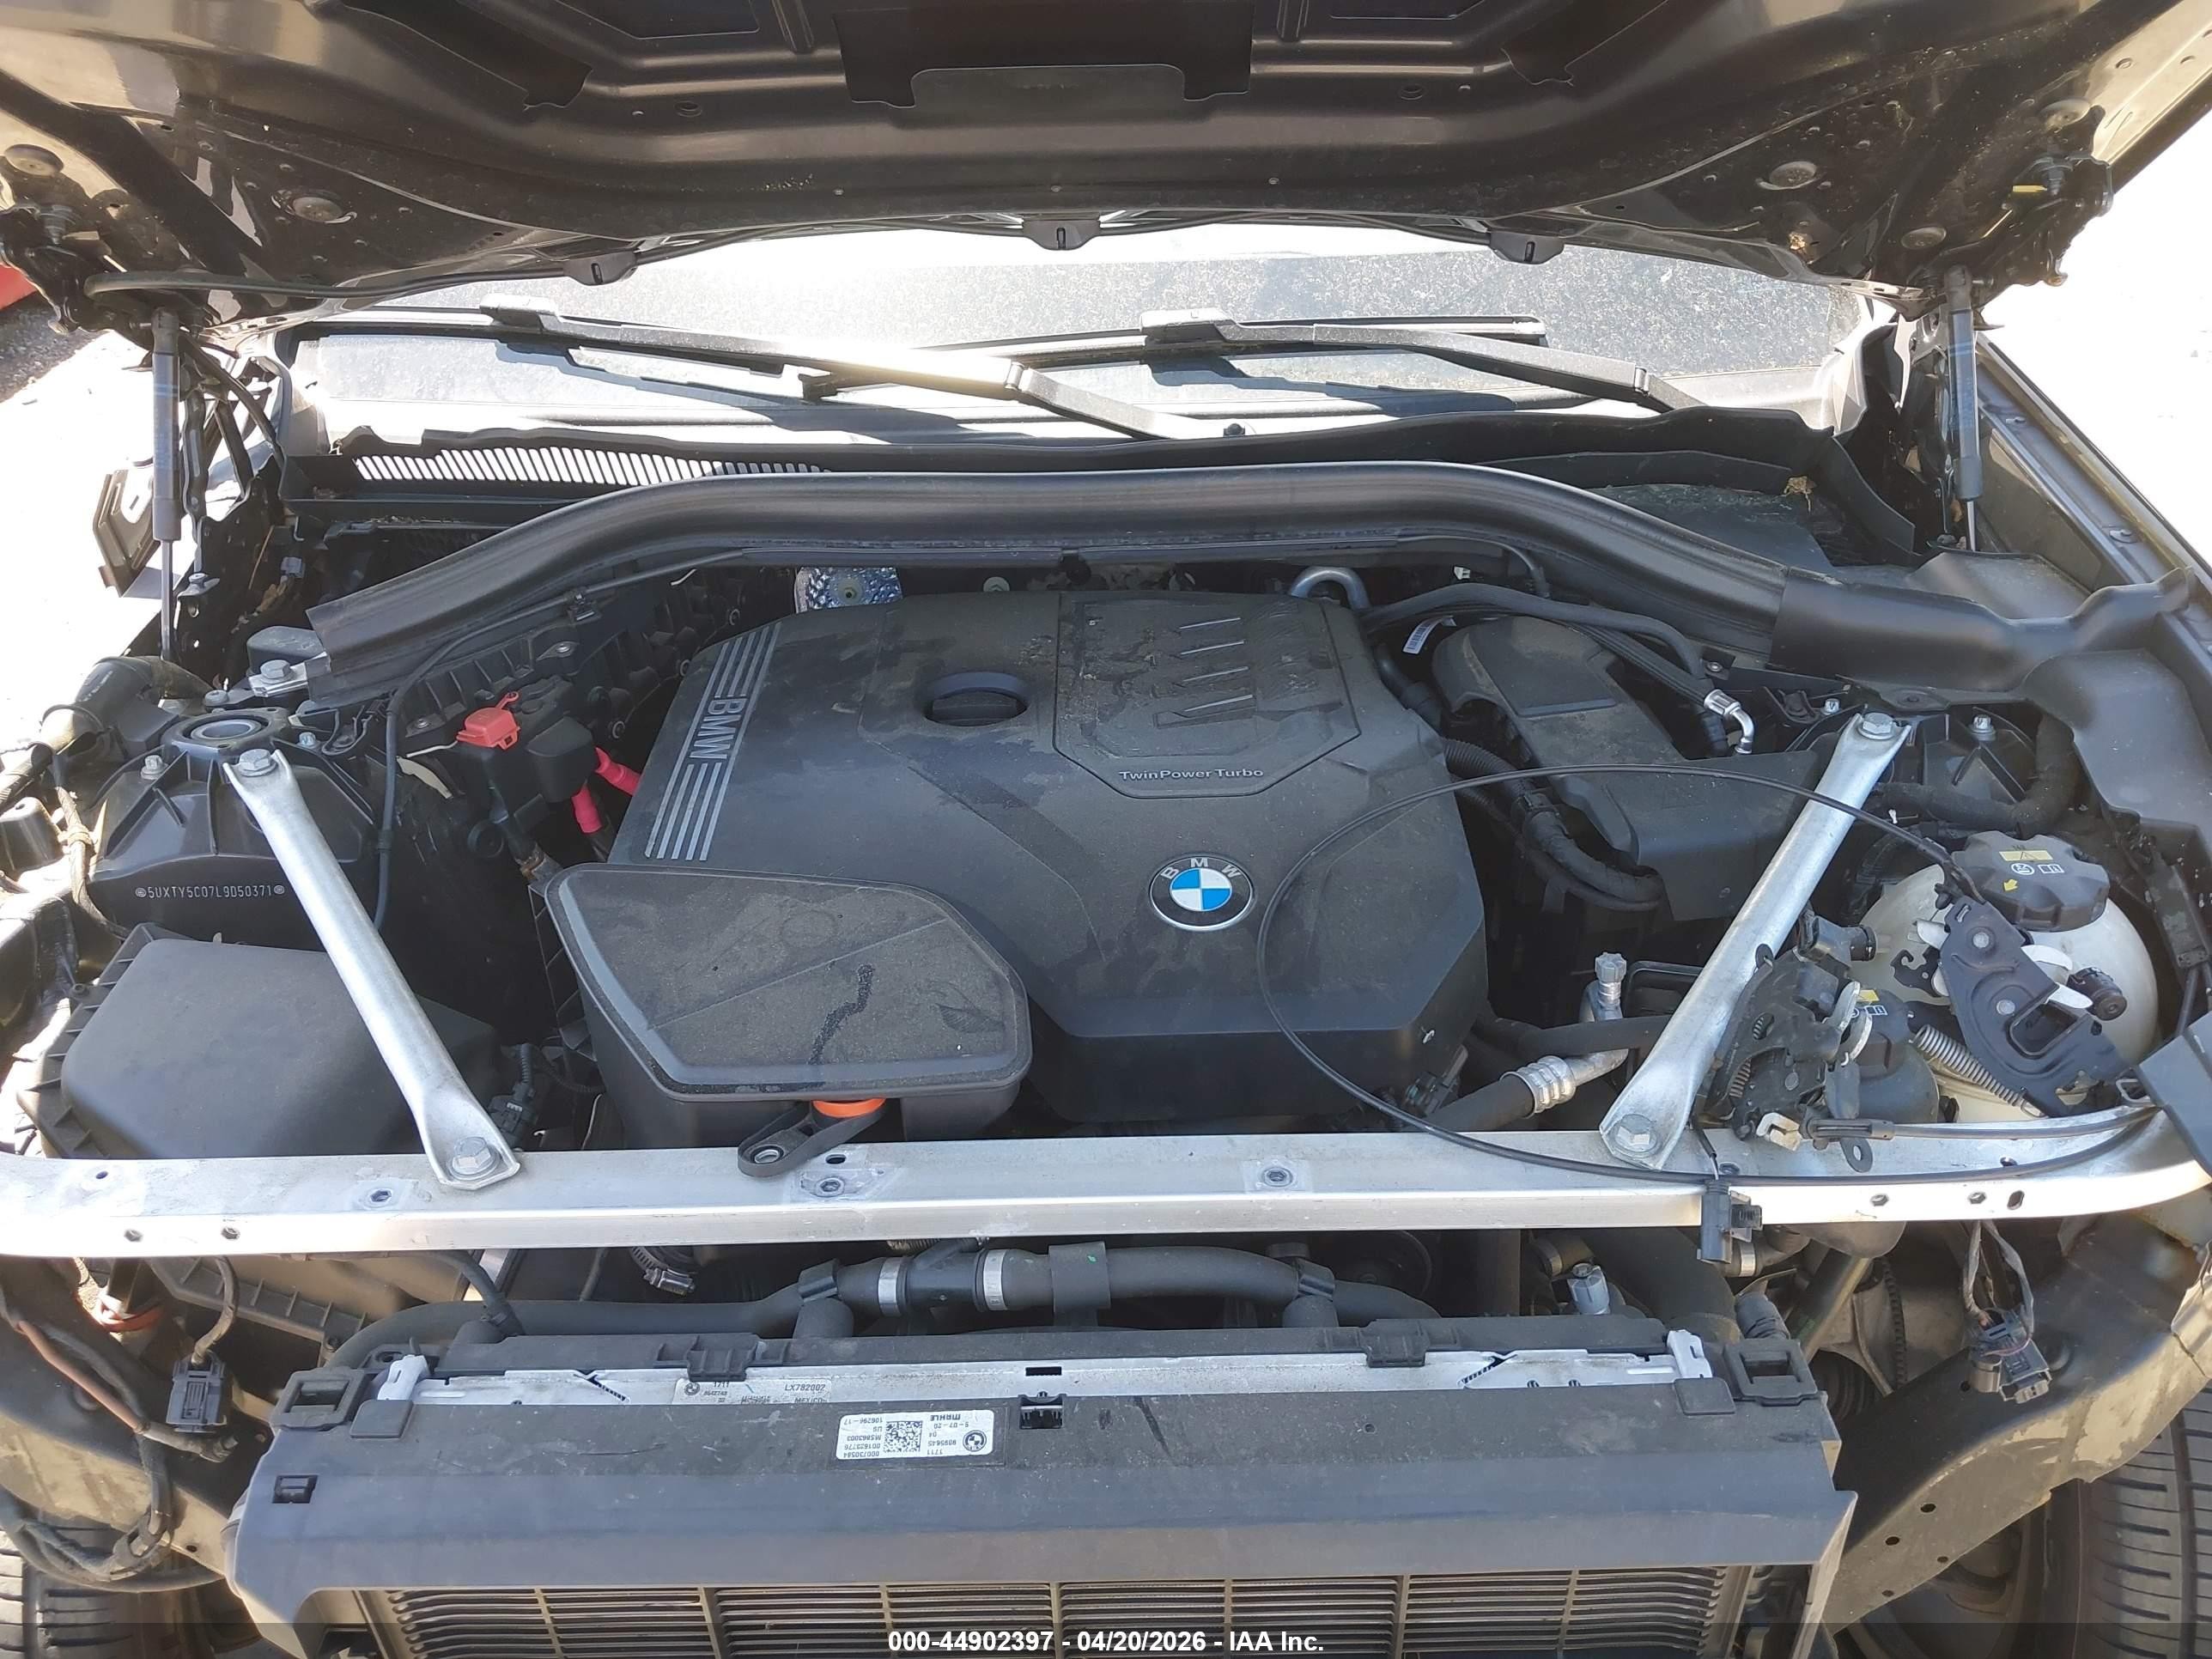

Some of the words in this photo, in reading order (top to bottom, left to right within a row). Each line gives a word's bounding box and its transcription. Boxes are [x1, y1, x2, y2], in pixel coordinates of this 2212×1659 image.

[690, 698, 747, 759] BMW
[1214, 769, 1264, 778] Turbo
[1160, 858, 1242, 880] BMW
[148, 884, 272, 898] 5UXTY5C07L9D50371
[784, 1383, 826, 1392] LX782002
